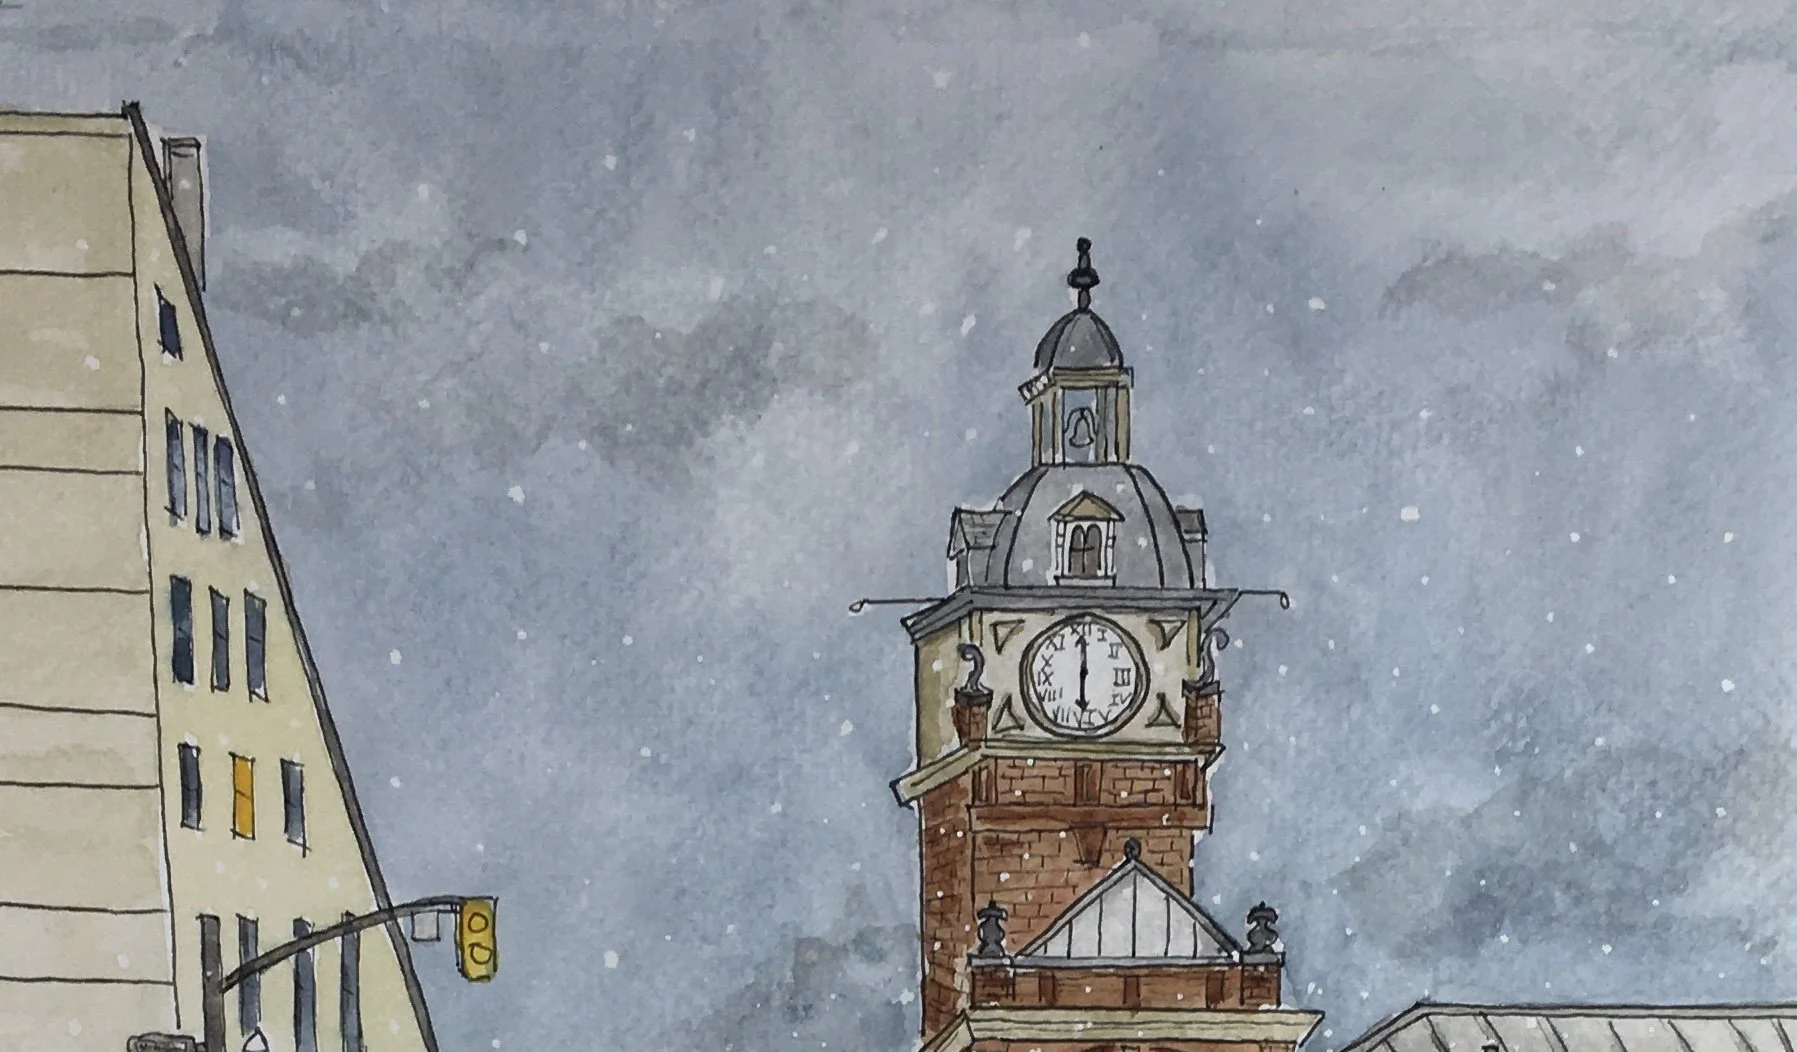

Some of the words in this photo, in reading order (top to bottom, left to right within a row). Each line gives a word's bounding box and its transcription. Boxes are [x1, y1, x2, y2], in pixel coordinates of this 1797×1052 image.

[1097, 627, 1107, 642] I
[1107, 642, 1122, 659] II
[1041, 654, 1054, 668] X
[1037, 668, 1054, 687] IX
[1112, 667, 1131, 687] III
[1038, 686, 1063, 702] VIII
[1107, 692, 1132, 707] IV
[1052, 706, 1071, 723] VII
[1098, 709, 1111, 722] V
